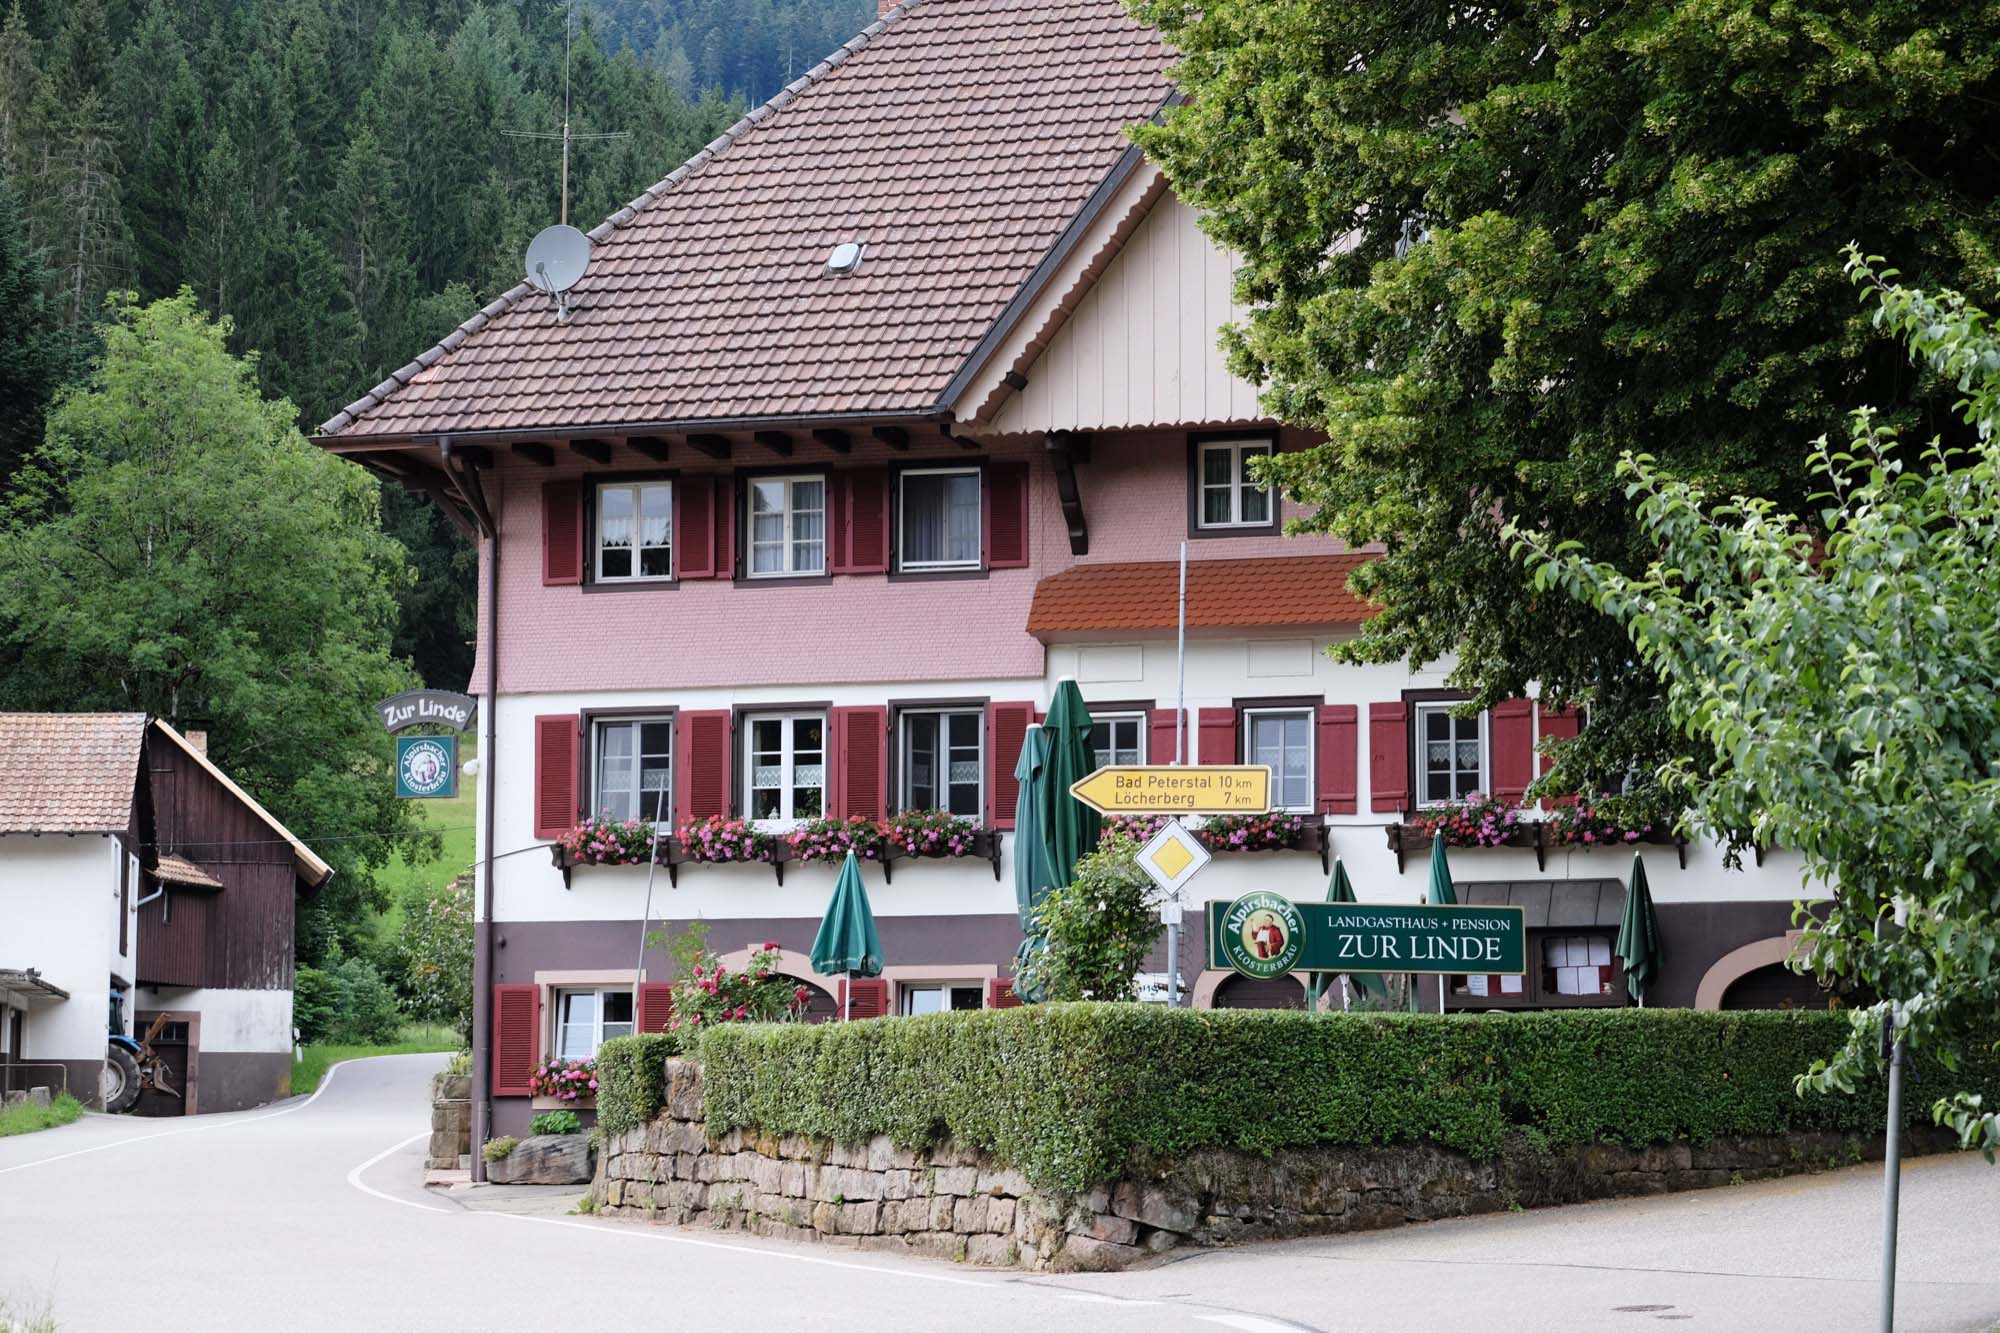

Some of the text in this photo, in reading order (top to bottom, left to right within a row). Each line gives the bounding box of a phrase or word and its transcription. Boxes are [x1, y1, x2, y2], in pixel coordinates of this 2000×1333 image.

[384, 699, 466, 726] Zur Linde
[404, 743, 446, 767] Alpirsbacher
[1116, 775, 1252, 788] Bad Peterstal 10 km
[1115, 792, 1251, 806] Löcherberg 7 km
[1227, 895, 1298, 935] Alpirsbacher
[1328, 916, 1438, 930] LANDGASTHAUS
[1452, 918, 1510, 931] PENSION
[1338, 934, 1503, 961] ZUR LINDE
